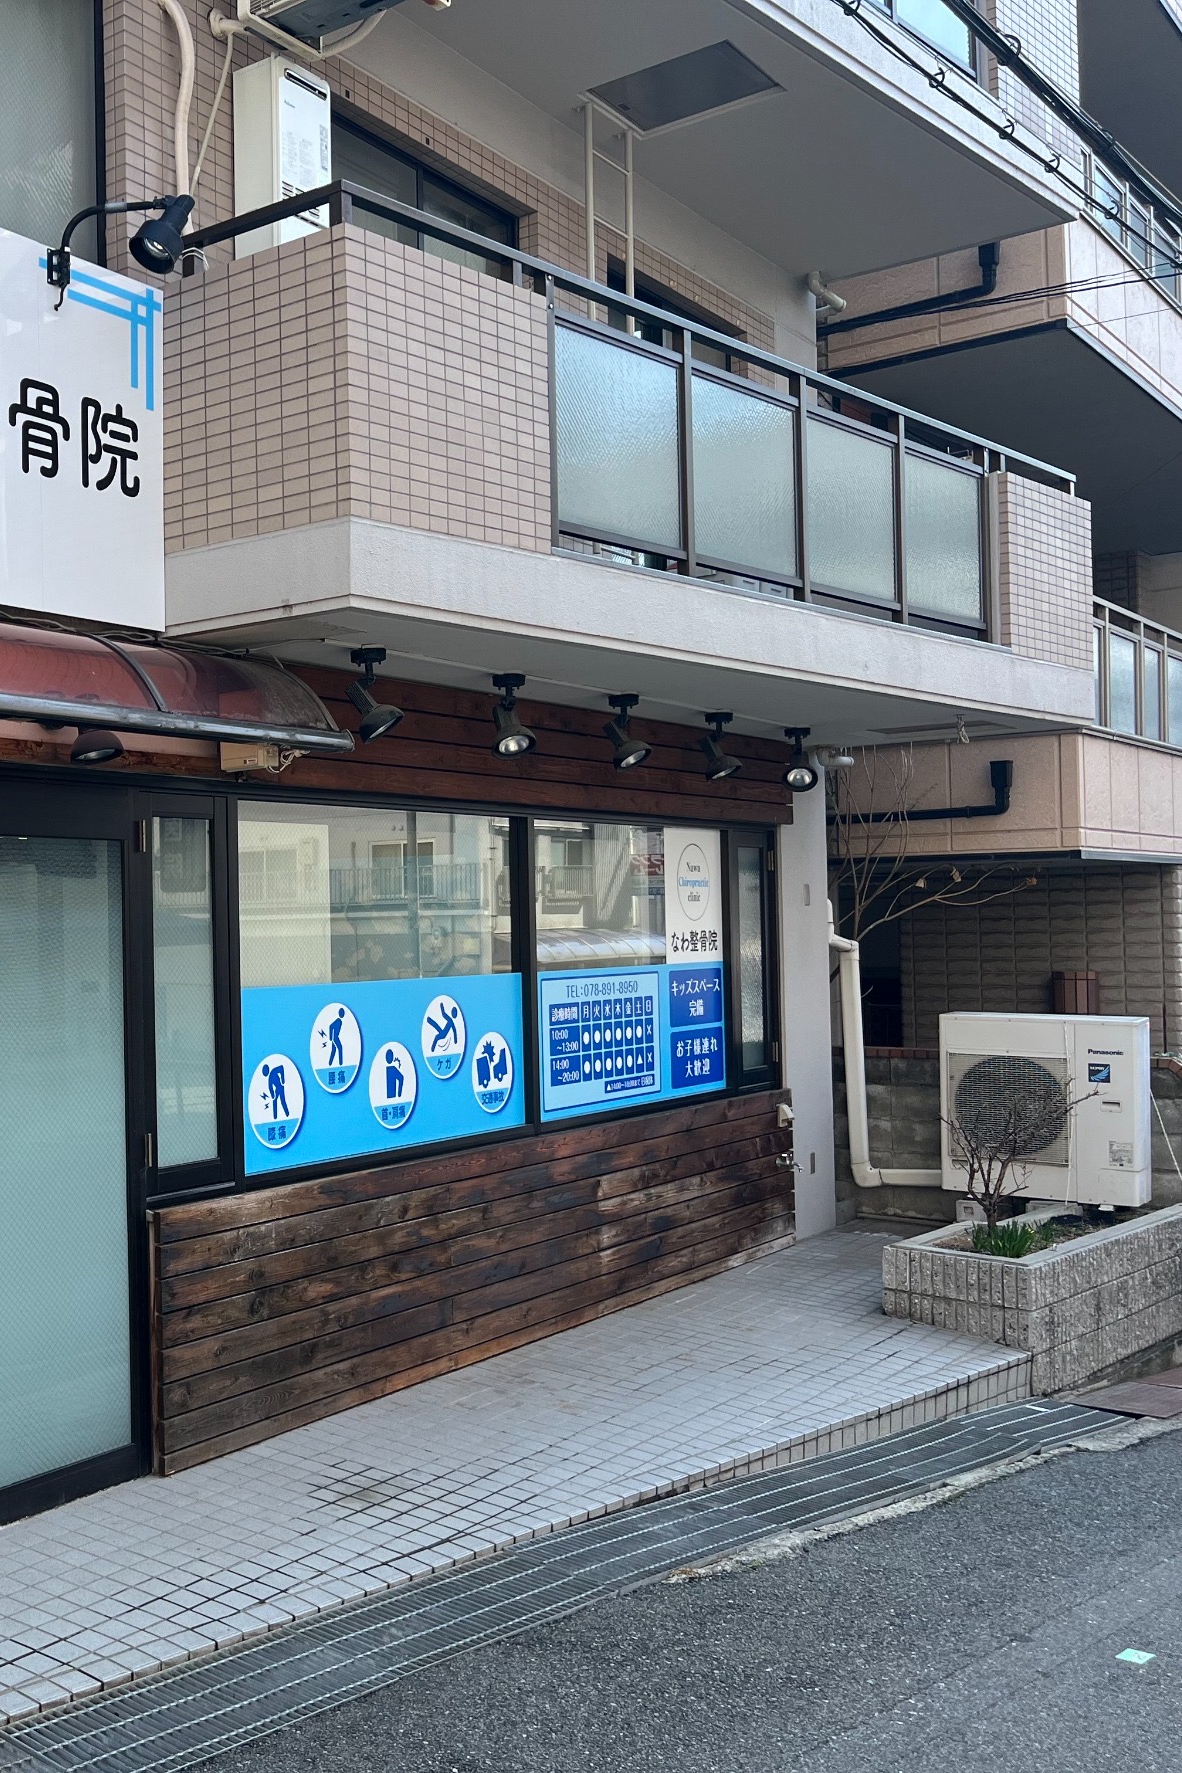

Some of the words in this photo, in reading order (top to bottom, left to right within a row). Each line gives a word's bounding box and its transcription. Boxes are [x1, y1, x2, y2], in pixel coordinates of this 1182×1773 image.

[686, 862, 700, 872] Nawa
[678, 877, 709, 888] Chiropractic
[687, 892, 700, 902] clinic
[671, 930, 718, 952] なわ整骨院
[566, 980, 638, 999] TEL:078-891-8950
[671, 978, 720, 997] キッズスペース
[583, 1004, 590, 1019] 月
[593, 1003, 601, 1018] 火
[604, 1003, 611, 1017] 水
[614, 1002, 622, 1016] 木
[625, 1001, 632, 1015] 金
[635, 1000, 643, 1014] 土
[645, 999, 652, 1012] 日
[551, 1029, 569, 1041] 10:00
[676, 1036, 718, 1057] お子様連れ
[436, 1058, 452, 1071] ケガ
[552, 1059, 569, 1071] 14:00
[685, 1058, 710, 1078] 大歓迎
[328, 1070, 346, 1085] 腰痛
[481, 1090, 505, 1105] 交通事故
[268, 1125, 287, 1141] 膝痛
